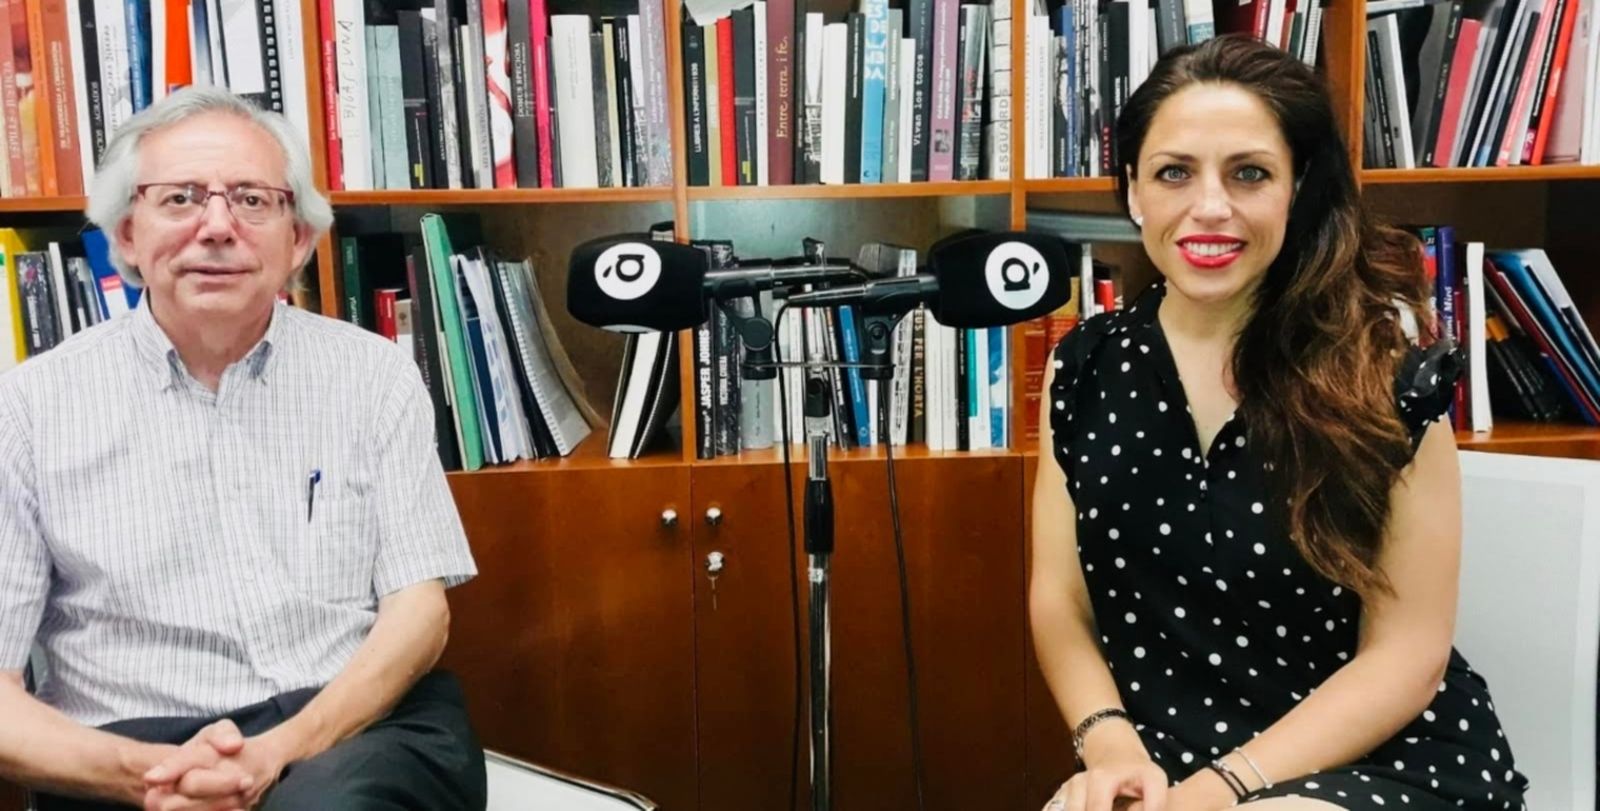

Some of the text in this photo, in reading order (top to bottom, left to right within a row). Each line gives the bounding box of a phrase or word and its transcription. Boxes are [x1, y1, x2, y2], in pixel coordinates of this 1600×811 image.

[915, 54, 923, 84] toros
[914, 90, 922, 107] los
[913, 114, 921, 145] Vivan
[999, 87, 1008, 172] ESGUARDS
[698, 329, 709, 364] JOHNS
[913, 309, 923, 417] EUS PER L'HORTA
[699, 367, 711, 408] JASPER
